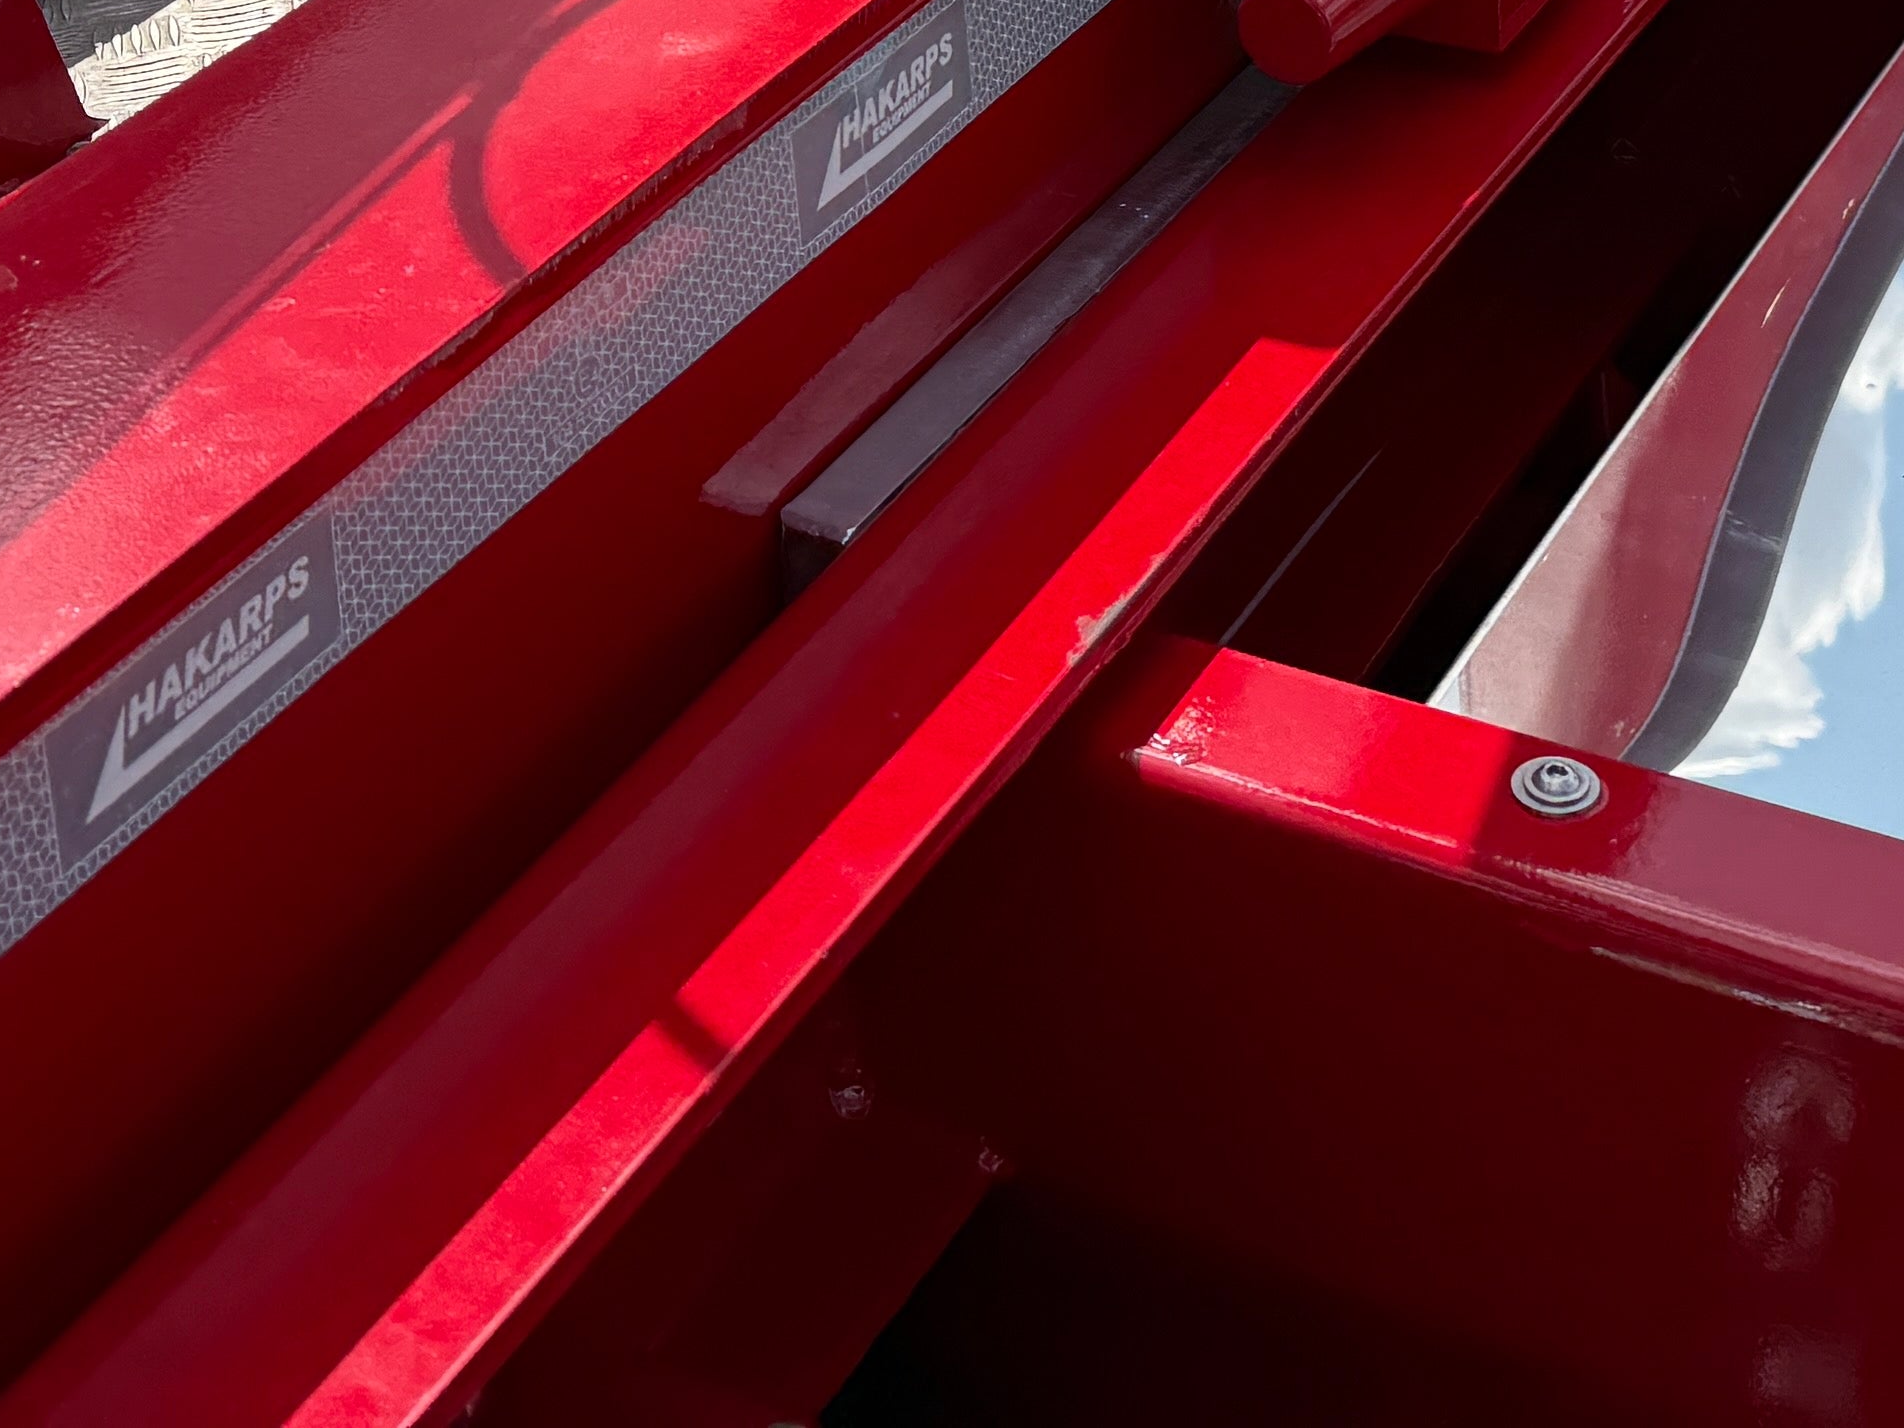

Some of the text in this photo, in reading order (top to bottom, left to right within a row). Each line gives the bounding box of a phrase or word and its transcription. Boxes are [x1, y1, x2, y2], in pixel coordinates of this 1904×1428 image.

[842, 32, 953, 149] HAKARPS
[126, 555, 310, 739] HAKARPS
[174, 623, 274, 721] EQUIPMENT
